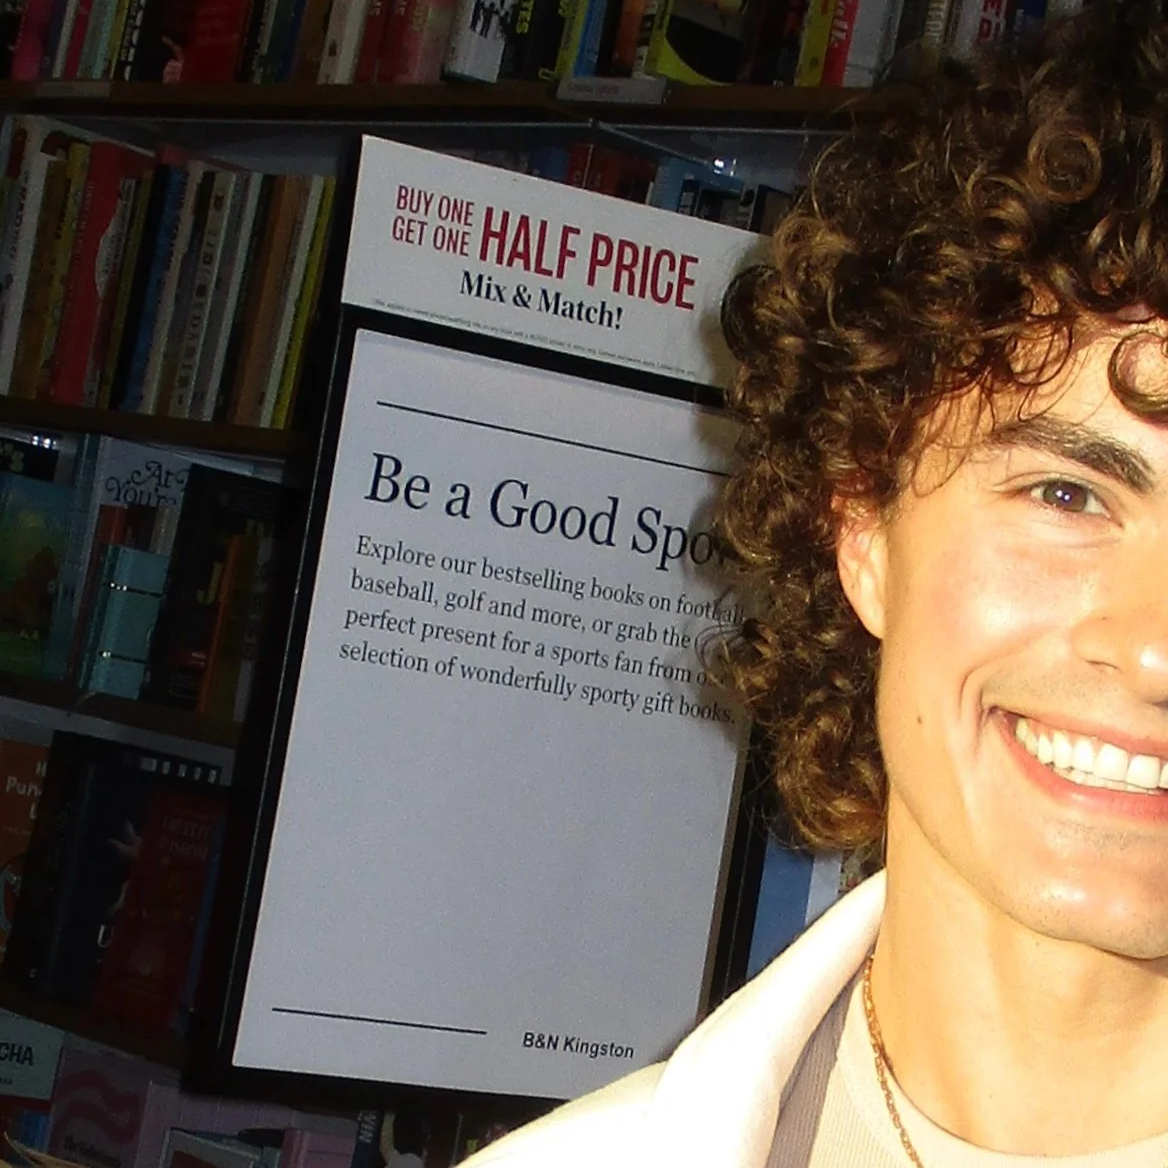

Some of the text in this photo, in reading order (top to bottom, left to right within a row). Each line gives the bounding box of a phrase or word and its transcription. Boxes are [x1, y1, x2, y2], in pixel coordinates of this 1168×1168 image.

[391, 215, 471, 257] GET ONE
[396, 184, 475, 228] BUY ONE
[479, 206, 700, 311] HALF PRICE
[459, 269, 625, 331] Mix & Match!
[363, 451, 724, 573] Be a Good Spo
[350, 567, 692, 650] baseball, golf and more, or grab the
[355, 533, 437, 570] Explore
[440, 555, 478, 578] our
[481, 555, 587, 601] bestselling
[590, 577, 646, 608] books
[647, 591, 672, 613] on
[338, 640, 736, 725] selection of wonderfully sporty gift books.
[343, 606, 418, 637] perfect
[420, 622, 497, 651] present
[502, 630, 531, 657] for
[534, 641, 547, 659] a
[550, 642, 611, 674] sports
[613, 648, 644, 677] fan
[647, 656, 692, 685] from
[522, 1031, 635, 1060] B&N Kingston
